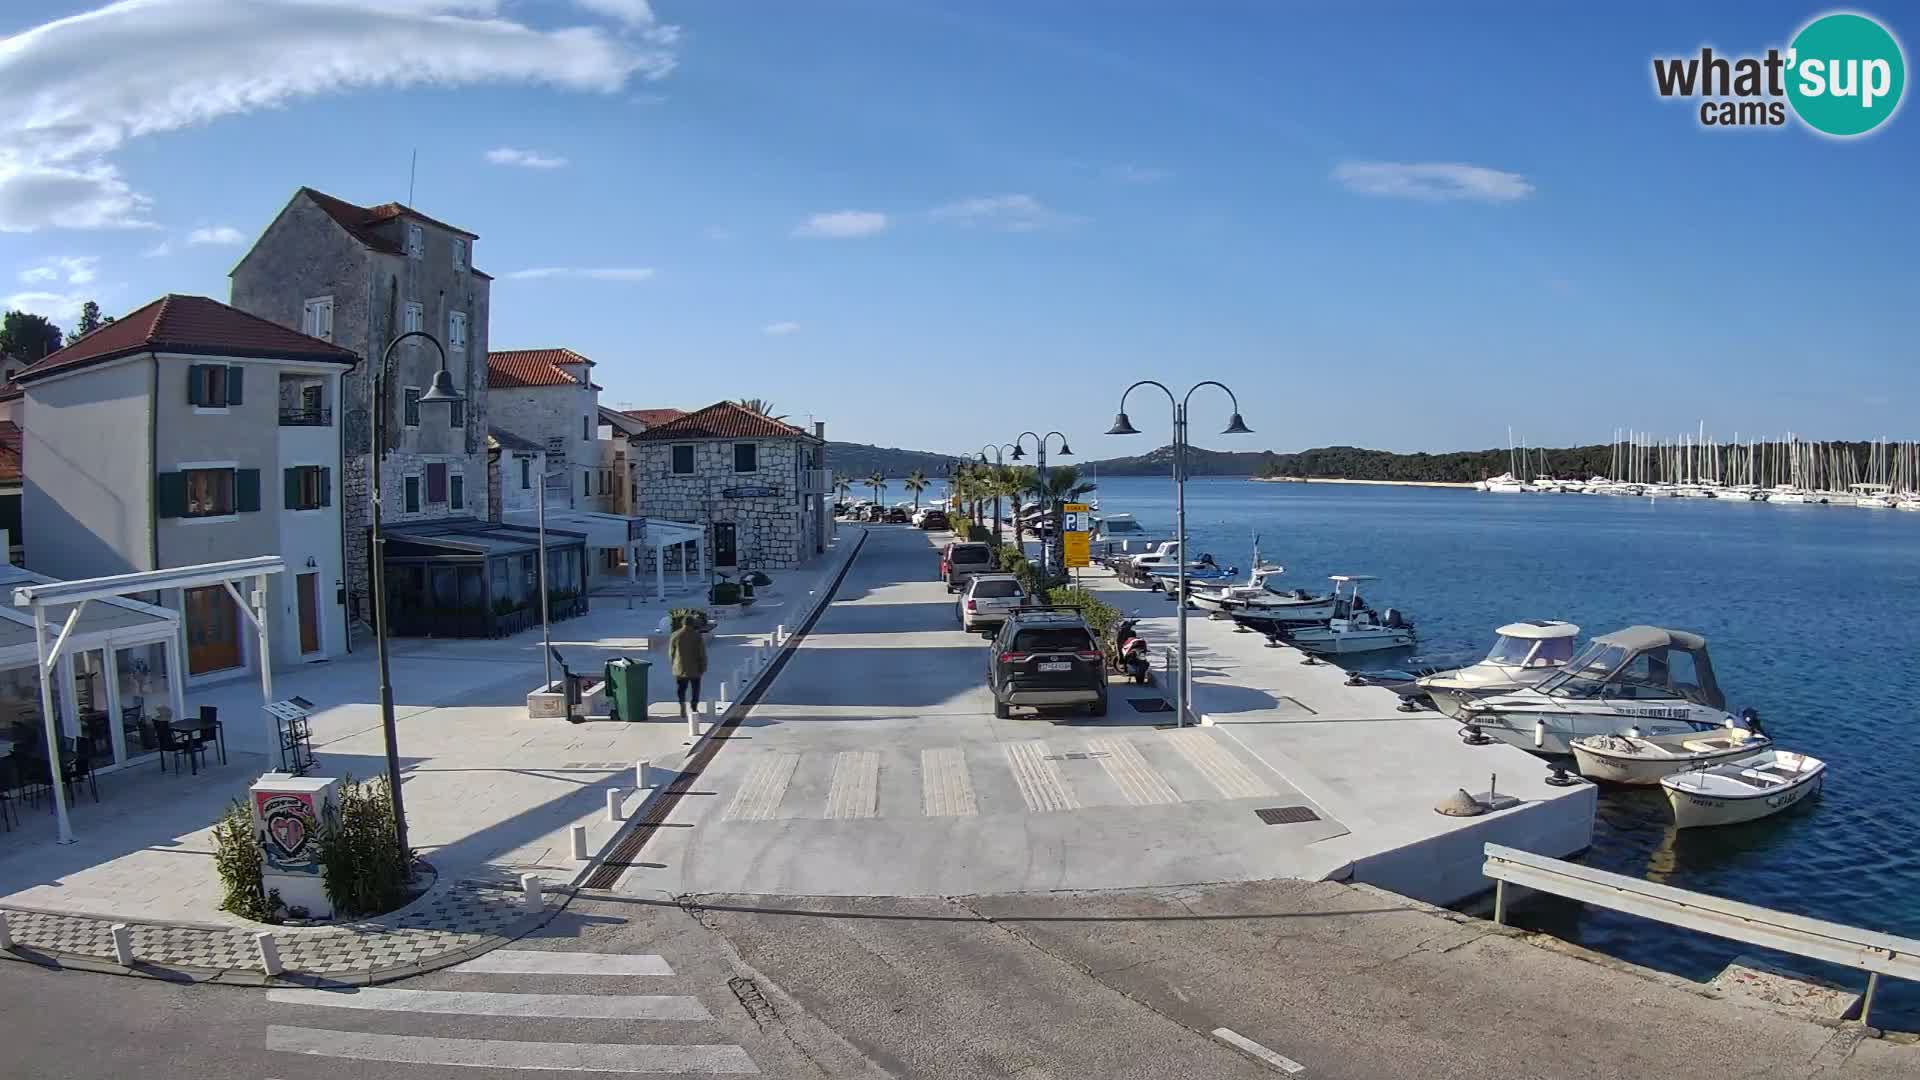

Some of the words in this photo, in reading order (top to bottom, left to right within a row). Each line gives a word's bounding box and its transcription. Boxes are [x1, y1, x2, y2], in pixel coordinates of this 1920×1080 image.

[1066, 514, 1076, 530] P
[1648, 708, 1666, 717] RENT
[1673, 708, 1691, 719] BOAT
